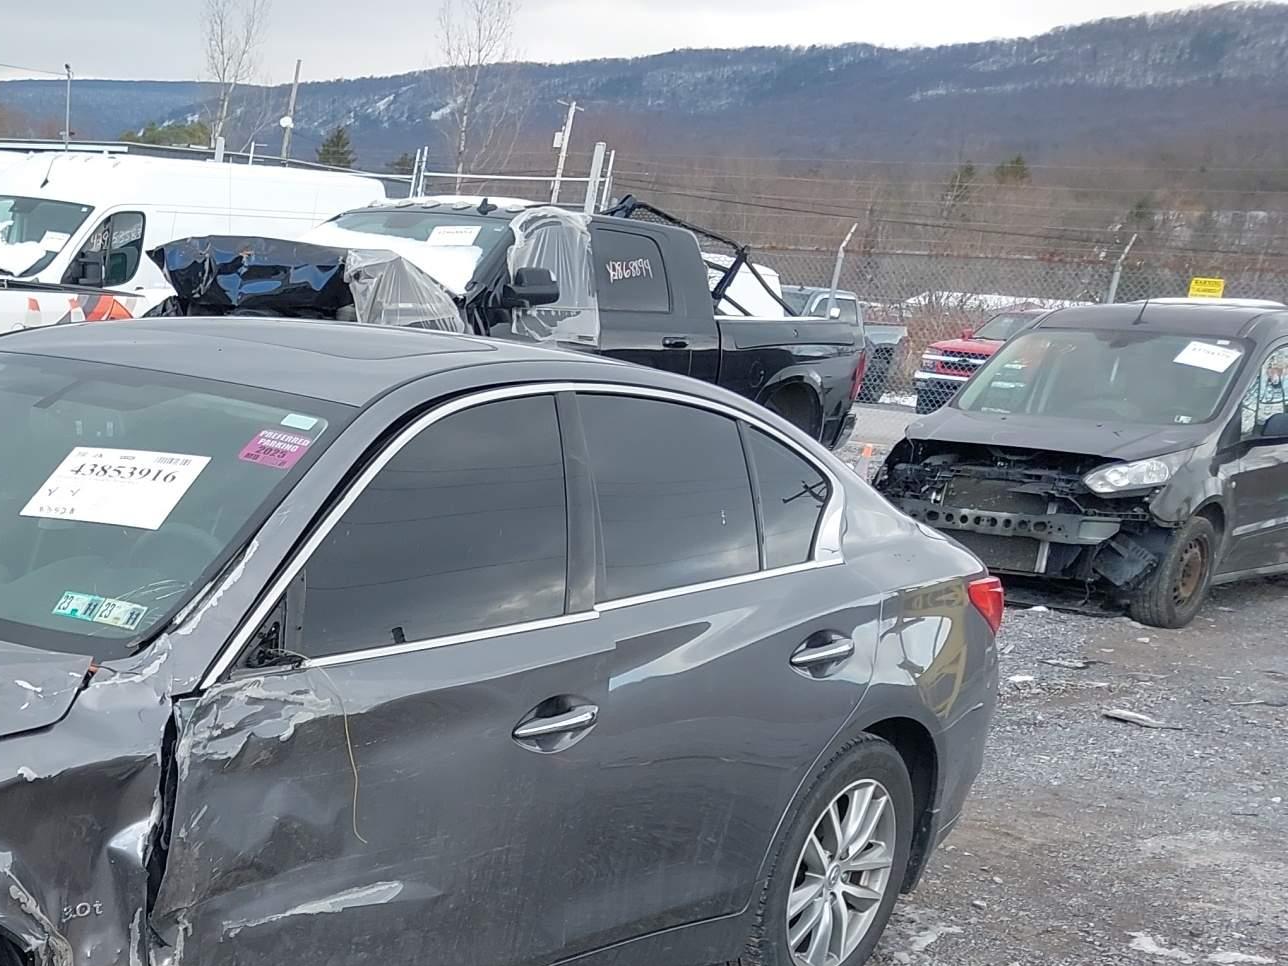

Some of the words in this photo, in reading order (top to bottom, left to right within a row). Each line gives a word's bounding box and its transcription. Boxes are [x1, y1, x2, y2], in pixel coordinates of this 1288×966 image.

[257, 438, 299, 452] PARKING
[259, 430, 310, 447] PREFERRED
[255, 445, 287, 459] 2025
[70, 462, 179, 484] 43853916
